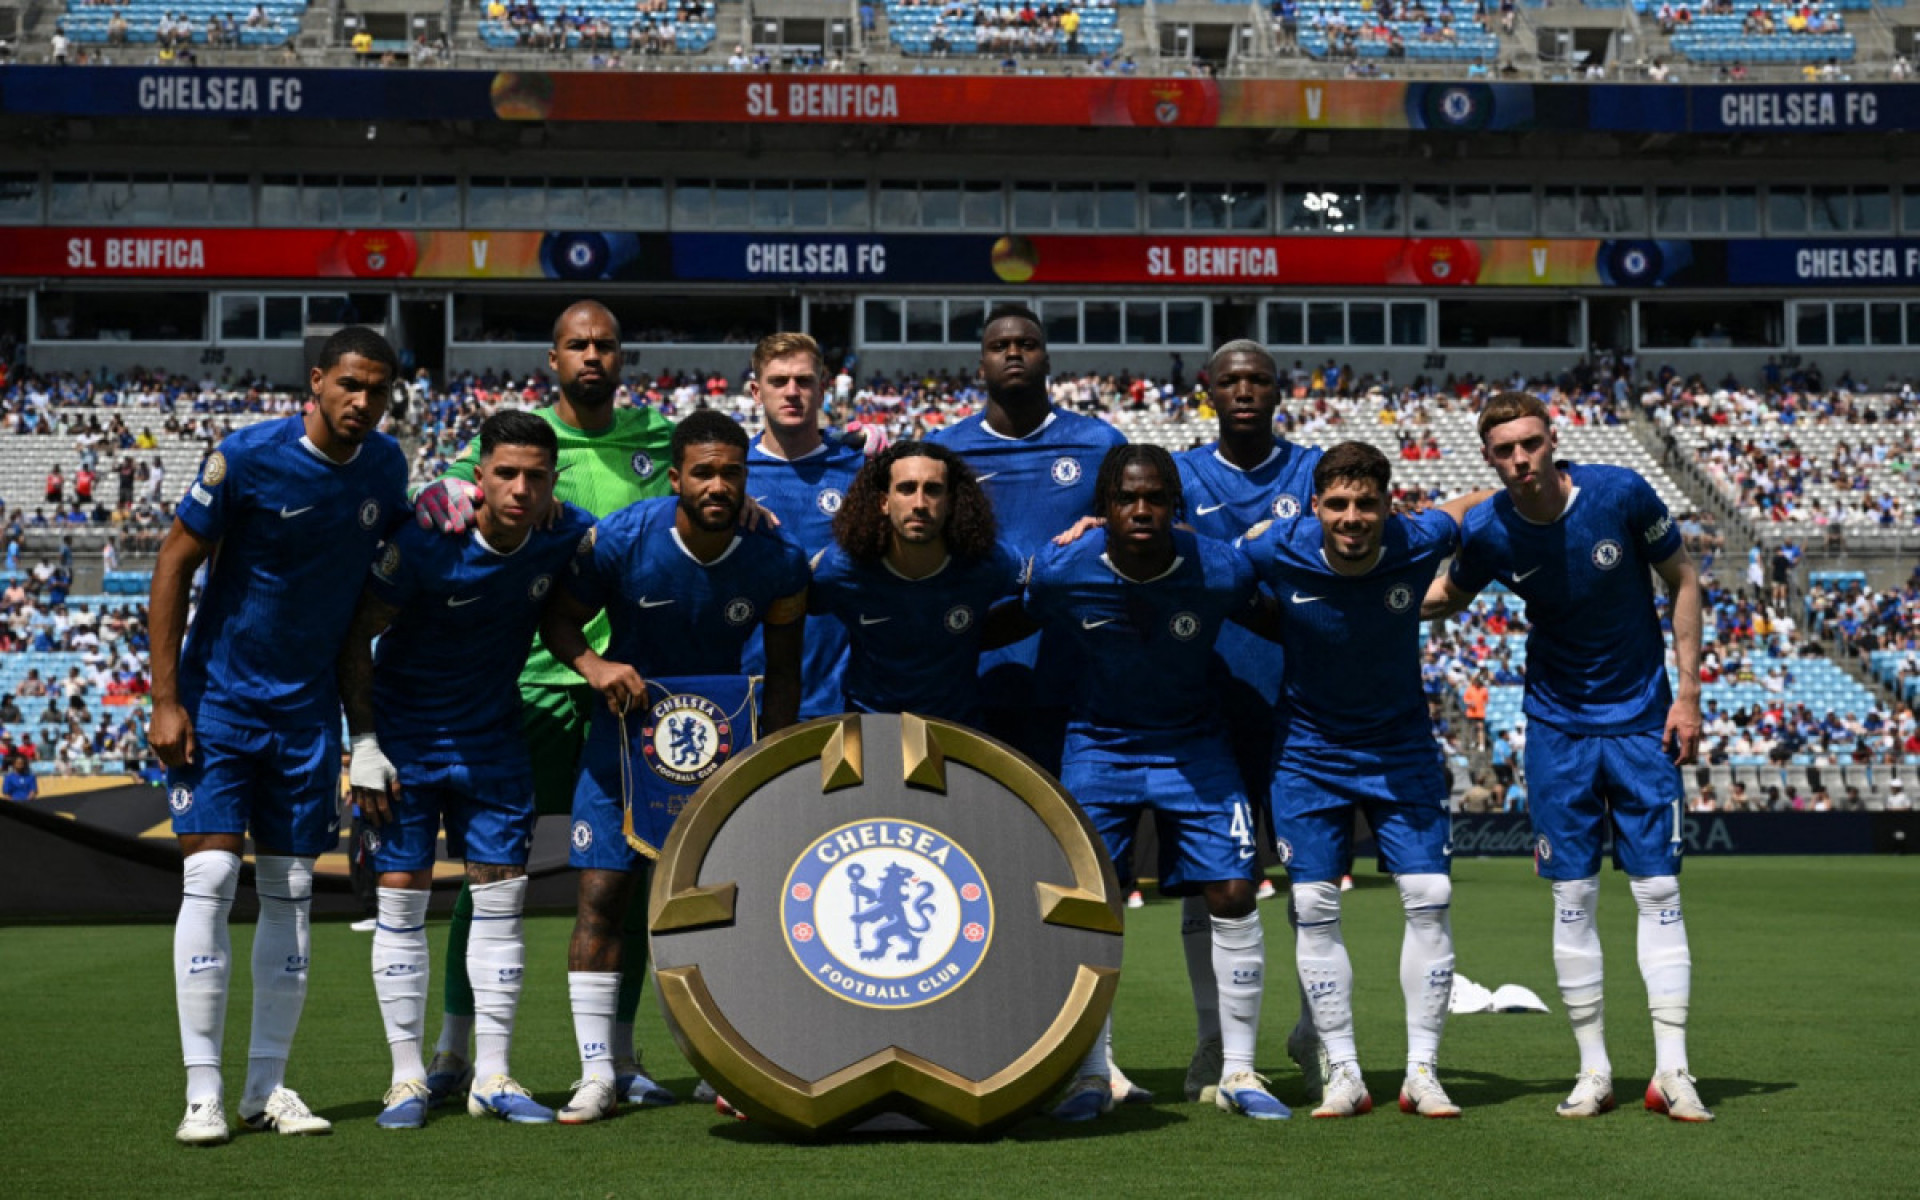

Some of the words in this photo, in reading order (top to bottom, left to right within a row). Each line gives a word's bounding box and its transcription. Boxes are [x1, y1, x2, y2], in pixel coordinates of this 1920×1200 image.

[139, 76, 258, 110] CHELSEA
[269, 76, 302, 111] FC
[747, 83, 779, 116] SL
[788, 83, 899, 117] BENFICA
[1305, 88, 1322, 120] V
[1721, 93, 1836, 126] CHELSEA
[1845, 93, 1878, 126] FC
[67, 238, 96, 268] SL
[105, 238, 205, 269] BENFICA
[472, 239, 488, 269] V
[745, 243, 849, 273] CHELSEA
[856, 244, 886, 273] FC
[1147, 246, 1176, 276] SL
[1183, 246, 1279, 276] BENFICA
[1531, 248, 1547, 277] V
[1796, 248, 1898, 278] CHELSEA
[1905, 248, 1920, 278] F
[655, 697, 715, 718] CHELSEA
[656, 764, 697, 781] FOOTBALL
[1230, 801, 1256, 847] 4
[1452, 818, 1538, 852] ichelo
[815, 824, 951, 866] CHELSEA
[818, 963, 911, 998] FOOTBALL
[917, 962, 961, 993] CLUB
[584, 1042, 607, 1051] CFC
